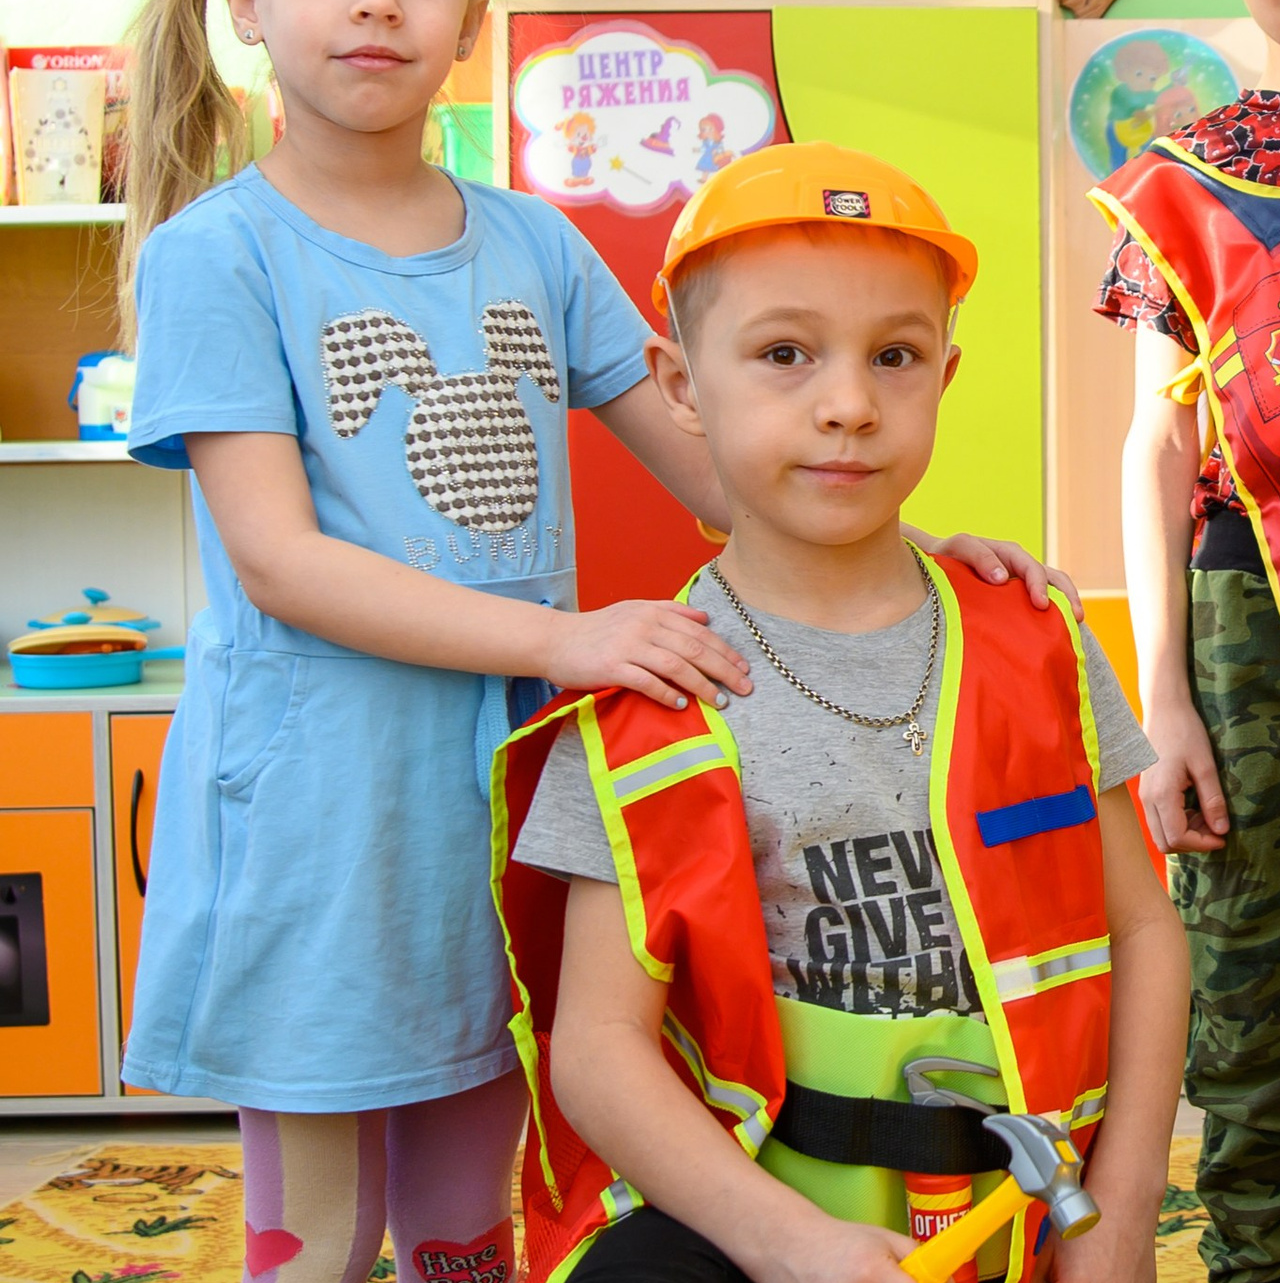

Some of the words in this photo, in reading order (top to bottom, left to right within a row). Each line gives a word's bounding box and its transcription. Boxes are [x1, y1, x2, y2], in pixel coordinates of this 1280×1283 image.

[50, 54, 103, 70] ORION
[577, 49, 664, 80] ЦЕНТР
[562, 76, 691, 110] РЯЖЕНИЯ
[835, 204, 865, 212] TOOLS
[403, 522, 562, 571] BUNY
[803, 829, 942, 903] NEV
[804, 890, 952, 963] GIVE
[420, 1244, 497, 1275] Hare
